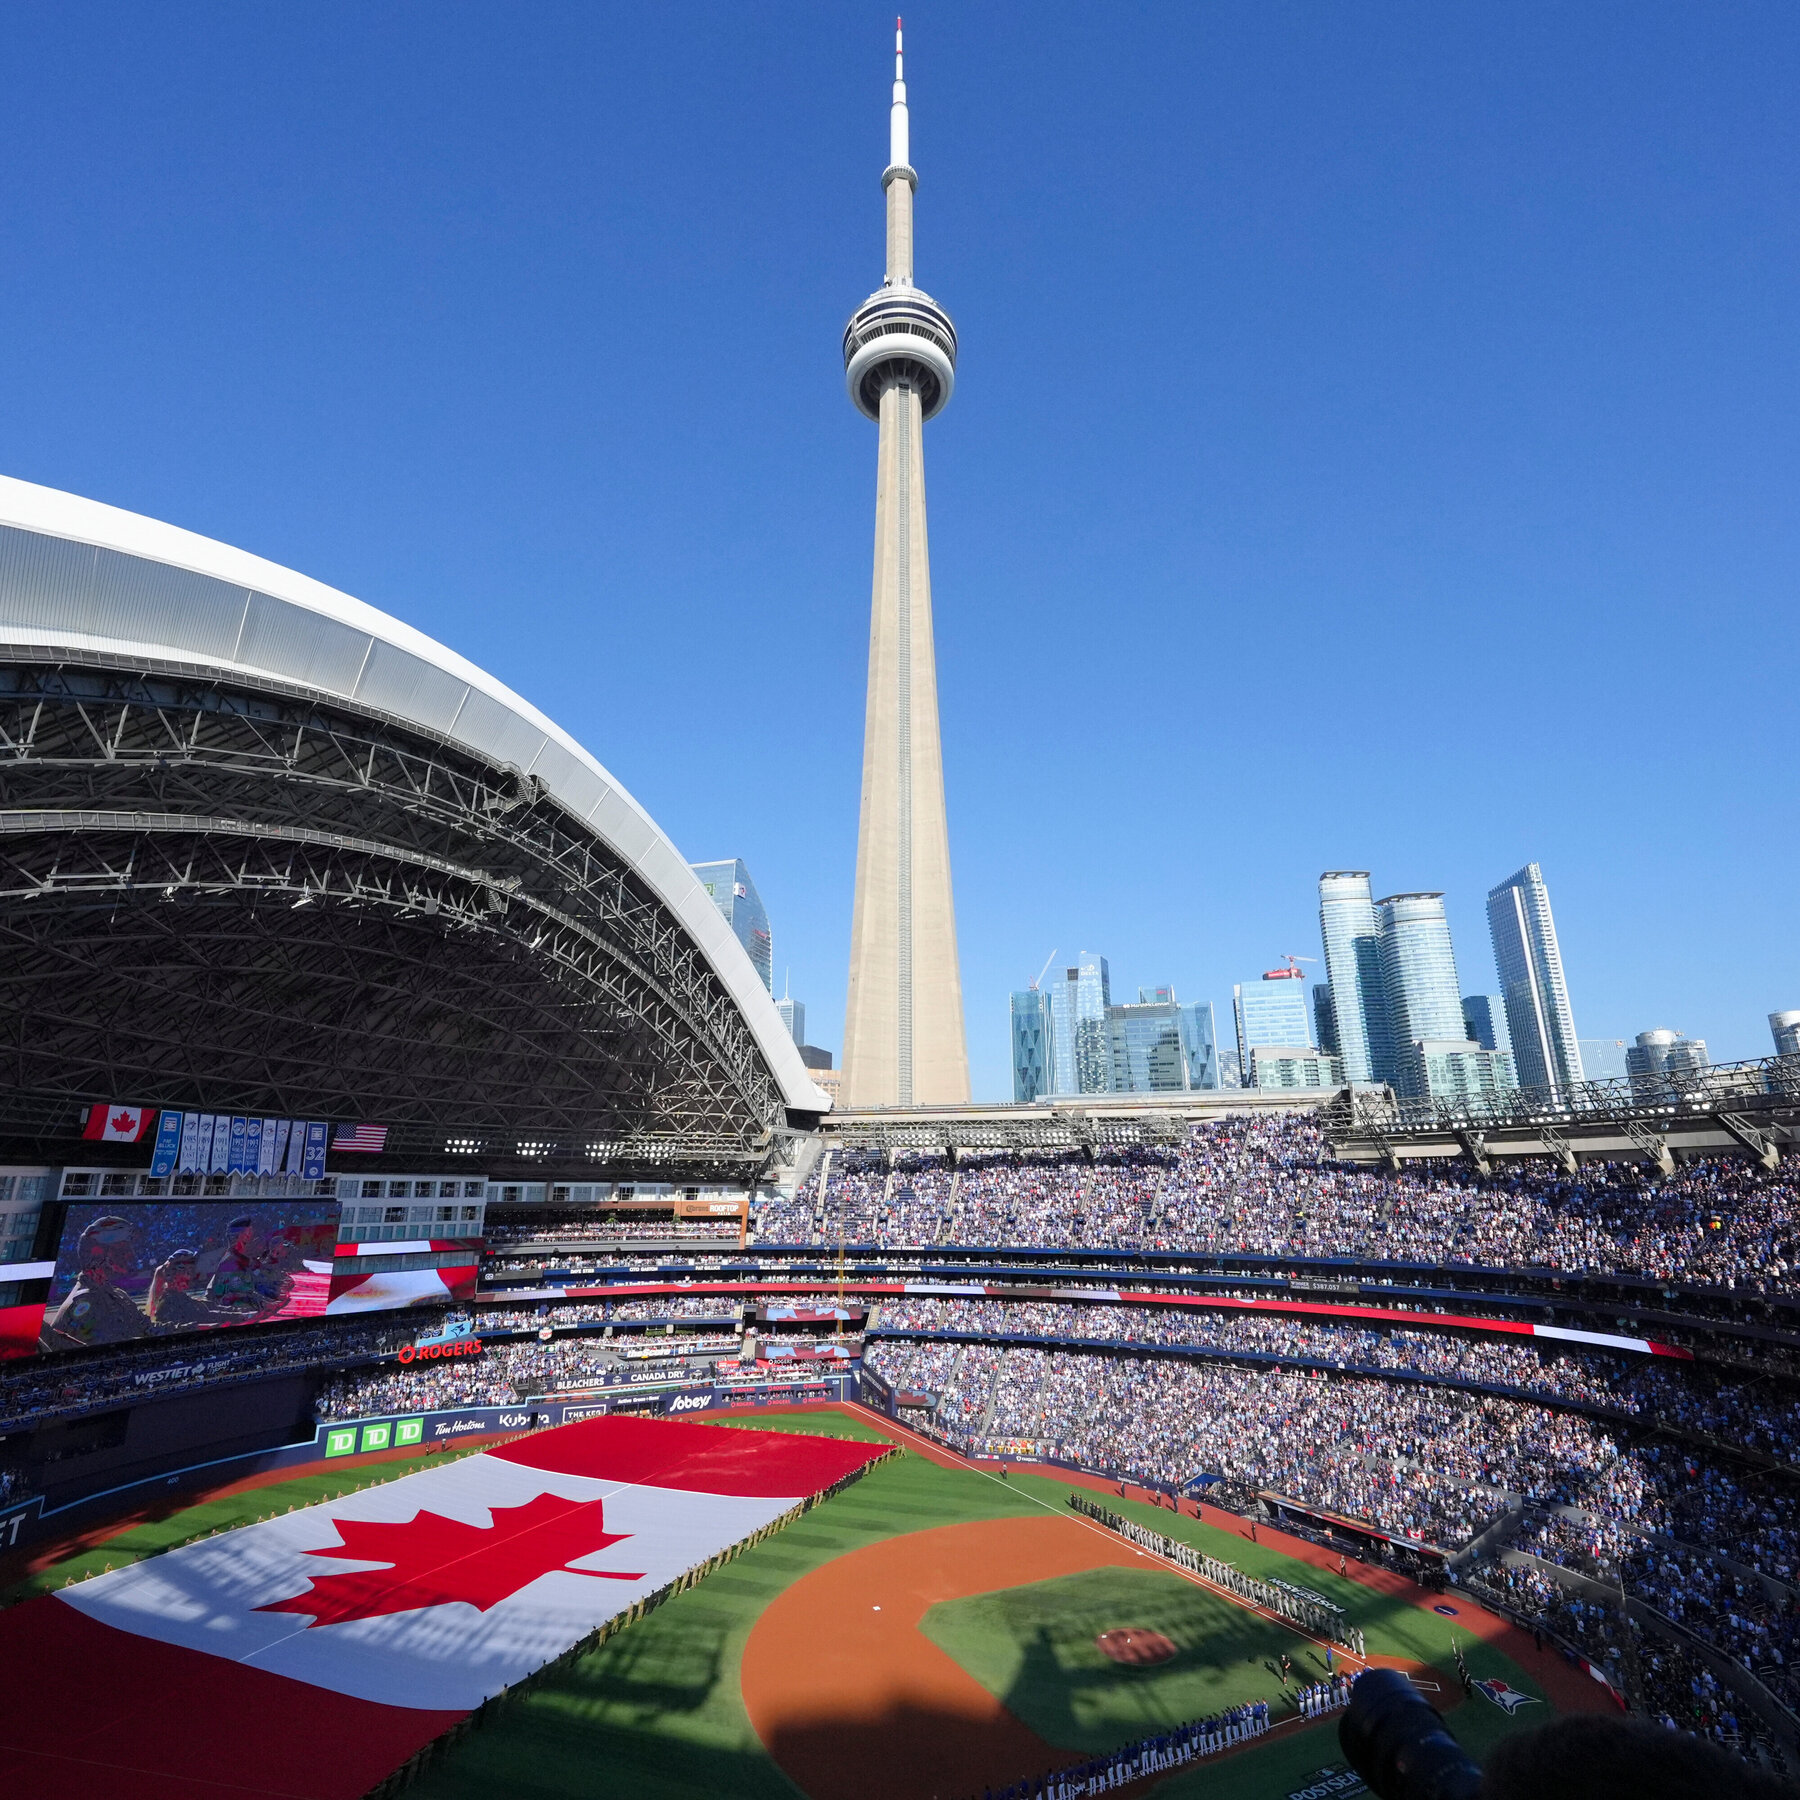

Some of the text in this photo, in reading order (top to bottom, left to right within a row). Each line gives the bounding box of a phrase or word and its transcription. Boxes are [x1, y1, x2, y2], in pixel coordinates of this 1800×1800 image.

[215, 1137, 228, 1145] 1991
[232, 1138, 244, 1146] 1992
[247, 1139, 259, 1147] 1993
[305, 1146, 325, 1160] 32
[709, 1204, 739, 1213] ROOFTOP
[418, 1339, 483, 1361] ROGERS
[678, 1345, 695, 1354] BET
[207, 1359, 231, 1370] FLIGHT
[557, 1377, 605, 1390] BLEACHERS
[630, 1372, 667, 1382] CANADA
[669, 1395, 712, 1412] Sobeys
[400, 1423, 420, 1440] TD
[435, 1420, 485, 1436] Tim Hortons
[331, 1433, 353, 1451] TD
[365, 1428, 388, 1446] TD
[1267, 1578, 1346, 1613] POSTSEASON
[1288, 1769, 1362, 1800] POSTSEA
